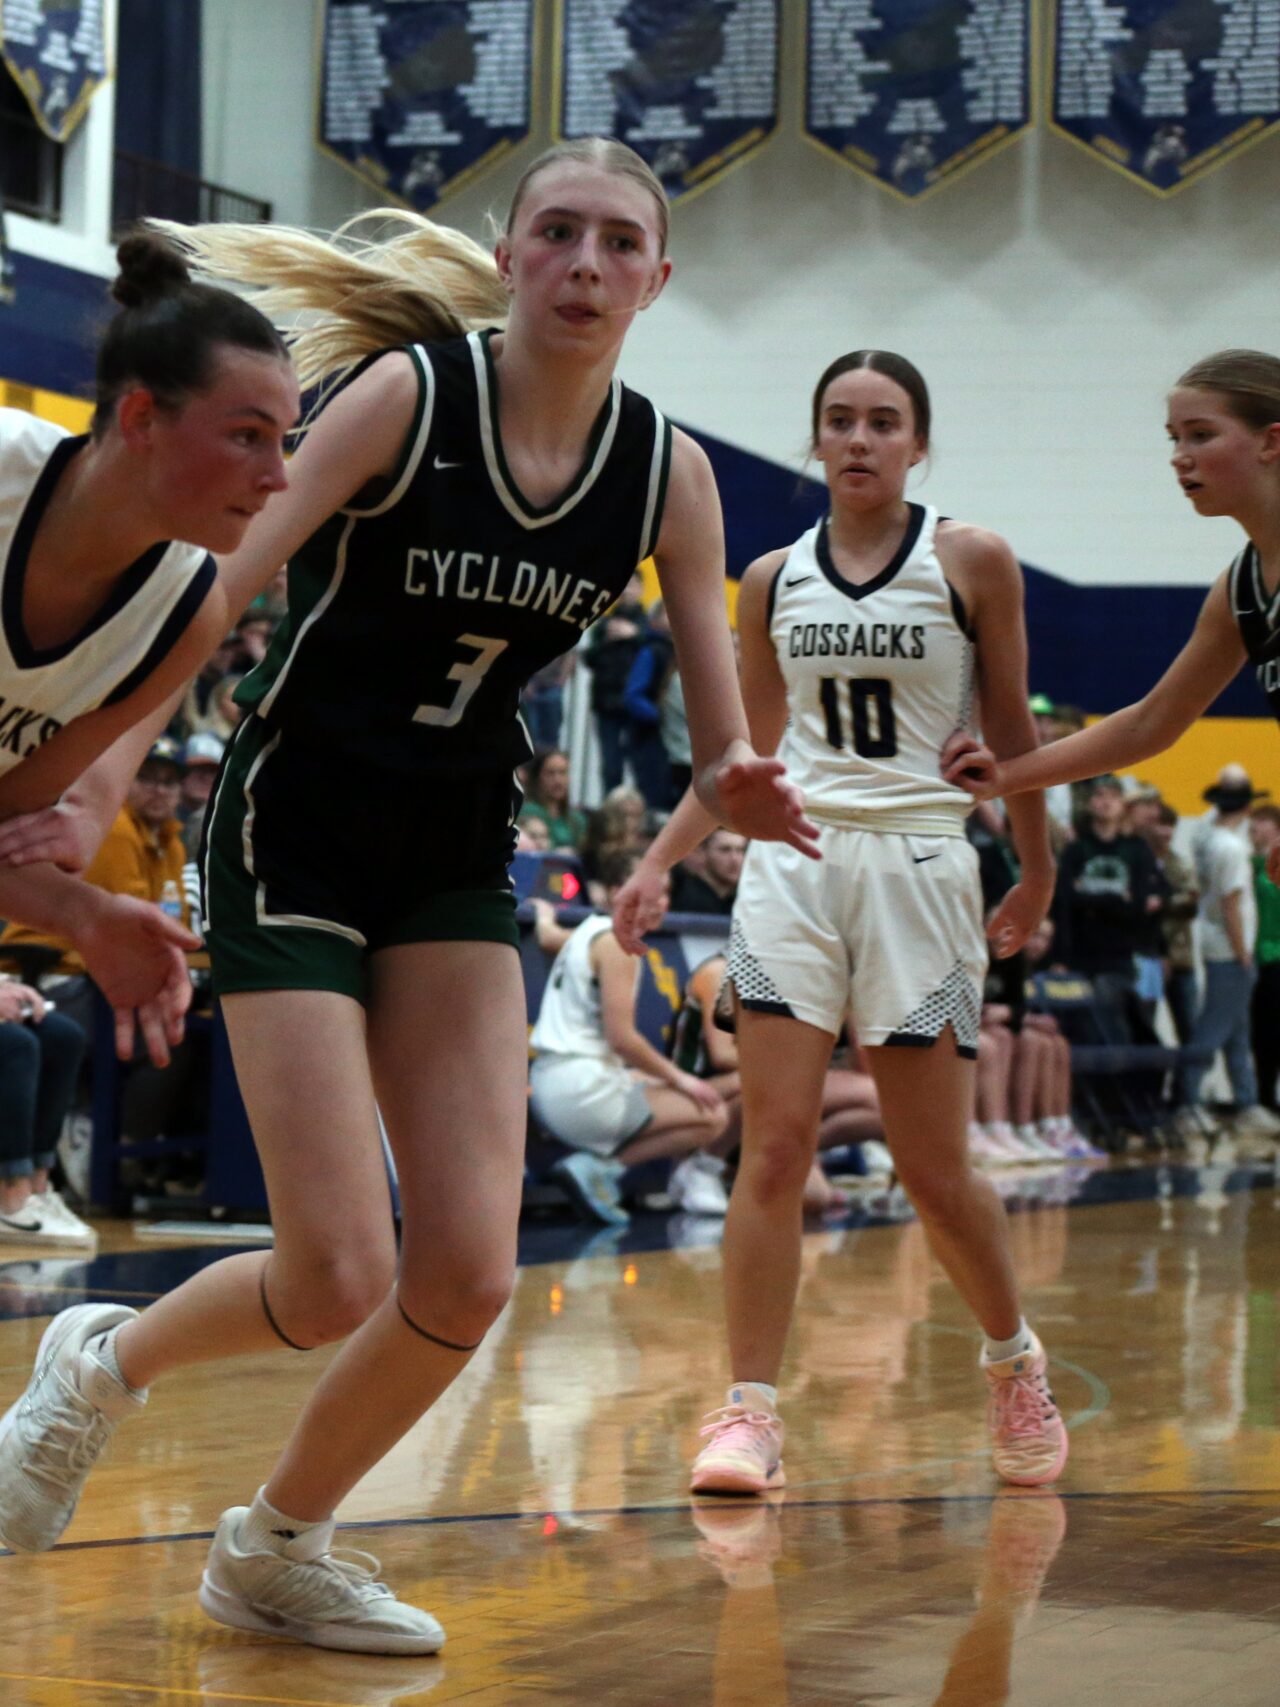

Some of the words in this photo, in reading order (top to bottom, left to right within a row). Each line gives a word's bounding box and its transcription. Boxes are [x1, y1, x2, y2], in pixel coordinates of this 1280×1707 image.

[403, 547, 612, 631] CYCLONES
[411, 632, 510, 728] 3
[789, 623, 926, 660] COSSACKS
[820, 676, 899, 759] 10
